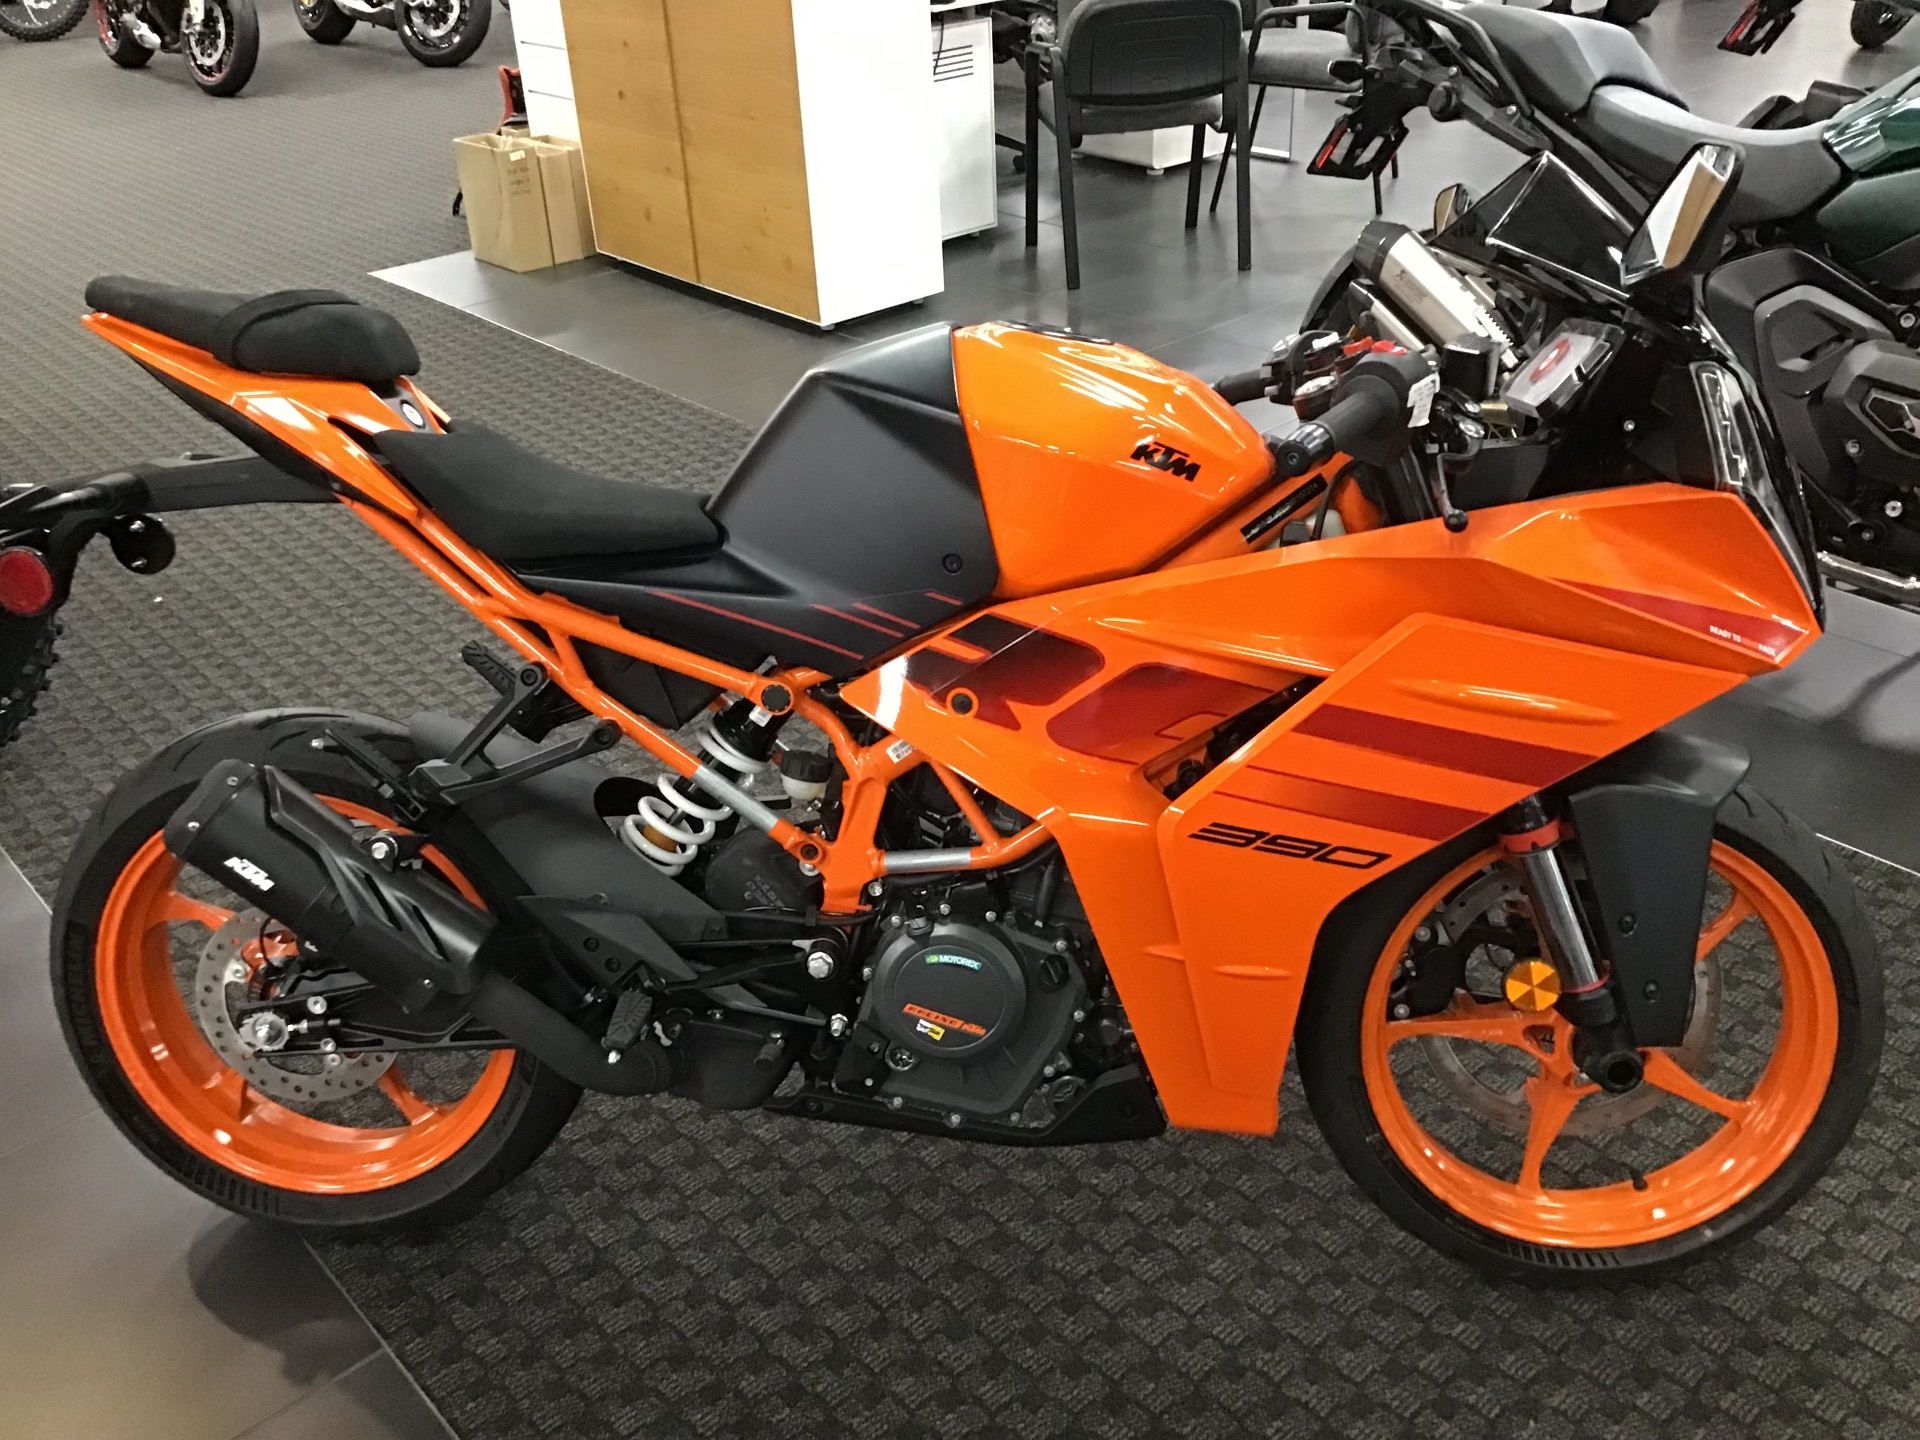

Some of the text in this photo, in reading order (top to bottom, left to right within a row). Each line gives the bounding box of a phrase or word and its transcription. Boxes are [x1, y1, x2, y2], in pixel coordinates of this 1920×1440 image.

[1130, 441, 1201, 482] KTM
[1732, 633, 1741, 643] TO
[1187, 822, 1392, 869] 390
[223, 856, 275, 891] KTM
[940, 955, 979, 969] MOTOREX
